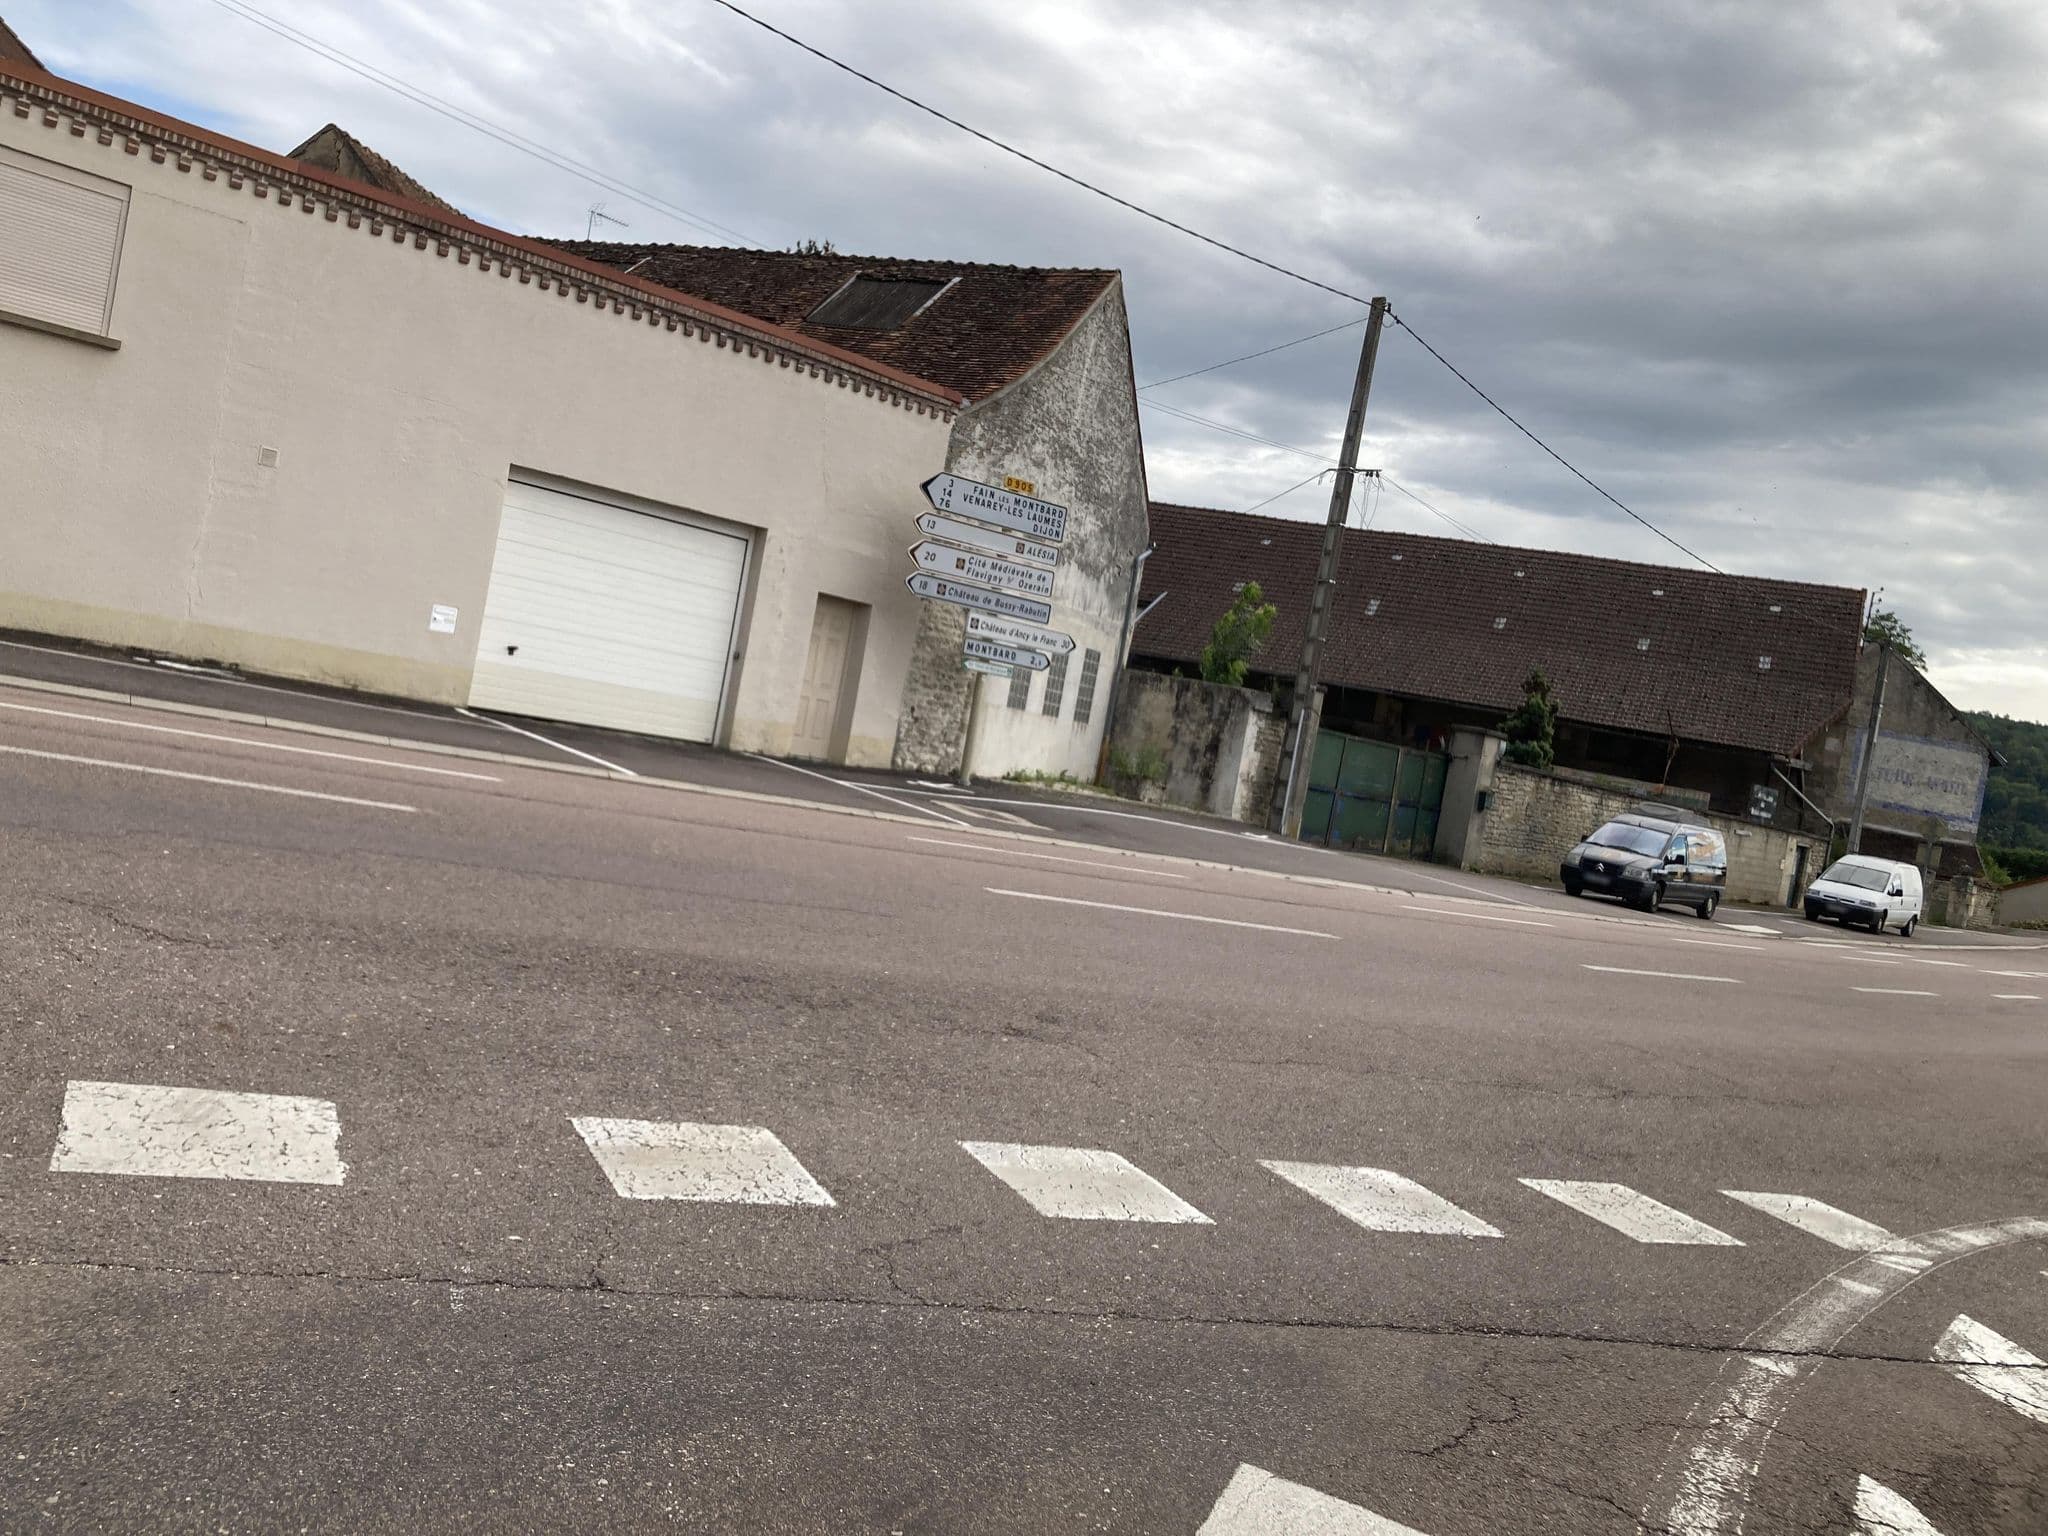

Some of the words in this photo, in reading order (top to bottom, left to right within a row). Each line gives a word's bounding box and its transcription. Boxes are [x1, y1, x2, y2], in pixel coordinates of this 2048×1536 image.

[949, 479, 954, 488] 3
[942, 488, 952, 497] 14
[939, 497, 951, 508] 76
[973, 486, 995, 499] FAIN
[1013, 497, 1064, 519] MONTBARD
[963, 493, 1023, 518] VENAREY-LES
[1027, 511, 1062, 529] LAUMES
[926, 519, 936, 530] 13
[1033, 524, 1061, 539] DIJON
[924, 551, 936, 562] 20
[968, 556, 987, 568] Cité
[990, 561, 1033, 580] Médiévale
[1037, 573, 1047, 582] de
[919, 580, 928, 590] 18
[966, 567, 1003, 584] Flavigny
[1018, 579, 1049, 594] Ozerain
[948, 587, 979, 602] Château
[983, 596, 992, 605] de
[994, 598, 1047, 617] Bussy-Rabutin
[980, 621, 1007, 635] Château
[966, 642, 1017, 660] MONTBARD
